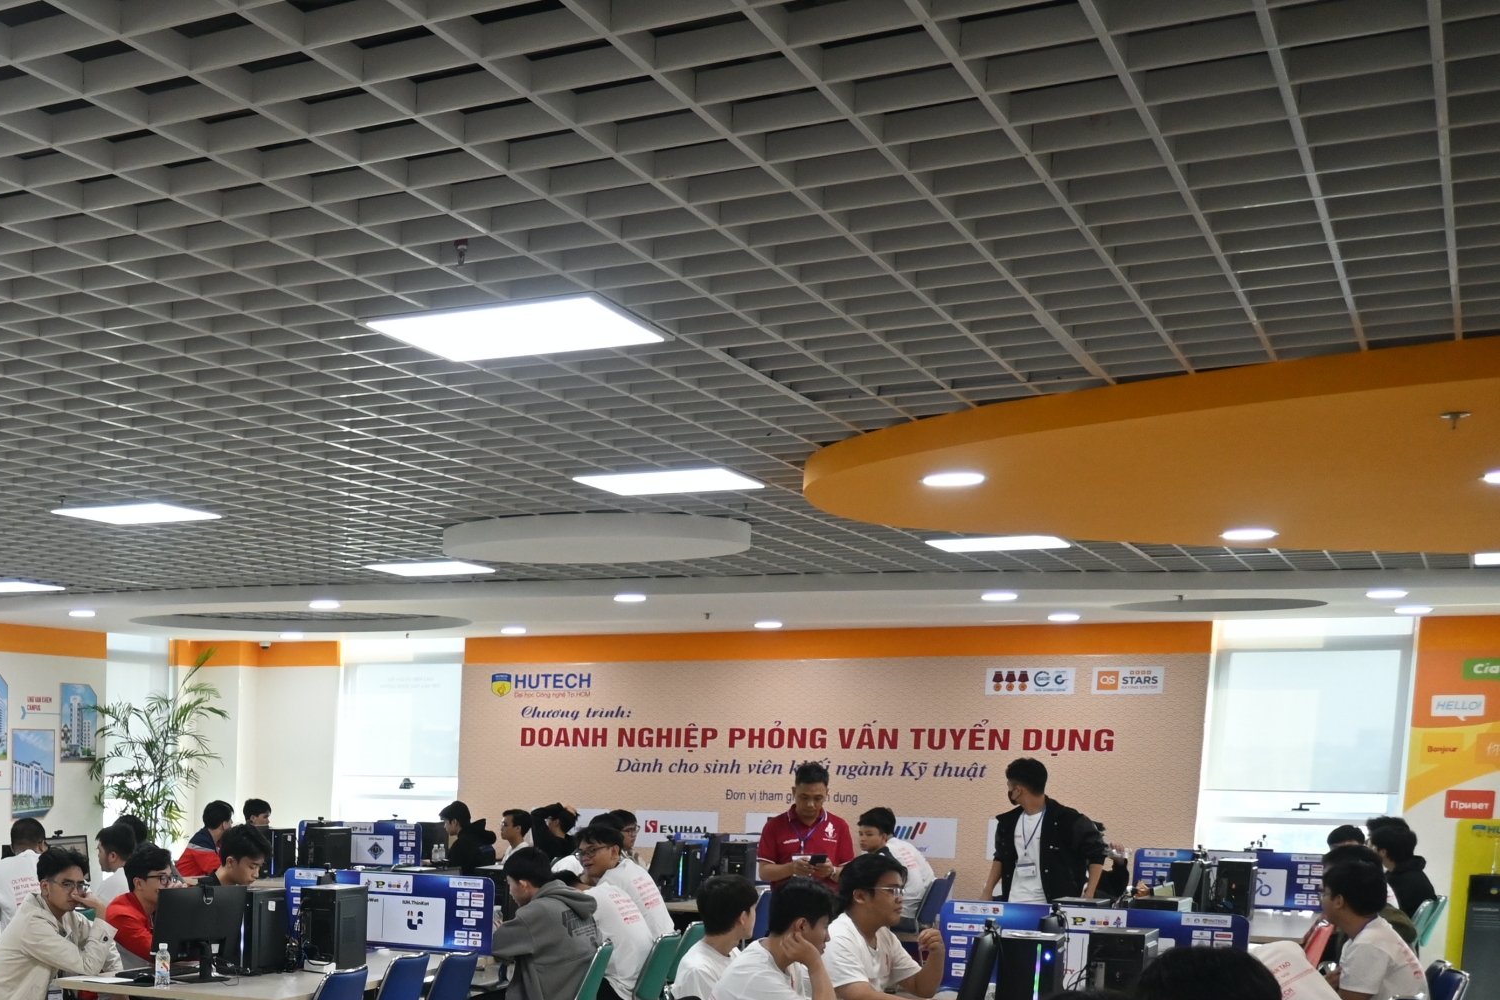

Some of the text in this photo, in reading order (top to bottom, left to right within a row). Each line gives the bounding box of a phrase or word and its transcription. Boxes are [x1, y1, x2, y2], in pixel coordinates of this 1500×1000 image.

[514, 673, 591, 689] HUTECH
[1100, 675, 1159, 686] QS STARS
[521, 705, 632, 721] Chương trình:
[1435, 701, 1482, 711] HELLO!
[520, 718, 1115, 757] DOANH NGHIỆP PHỎNG VẤN TUYỂN DỤNG
[1427, 745, 1458, 755] Bonjour
[615, 758, 664, 773] Dành
[668, 759, 699, 774] cho
[703, 759, 741, 774] sinh
[747, 760, 783, 775] viên
[836, 760, 894, 779] ngành
[900, 761, 928, 780] Kỹ
[932, 761, 988, 781] thuật
[725, 789, 858, 806] Đơn vị tham dụng
[1450, 800, 1490, 811] Привет
